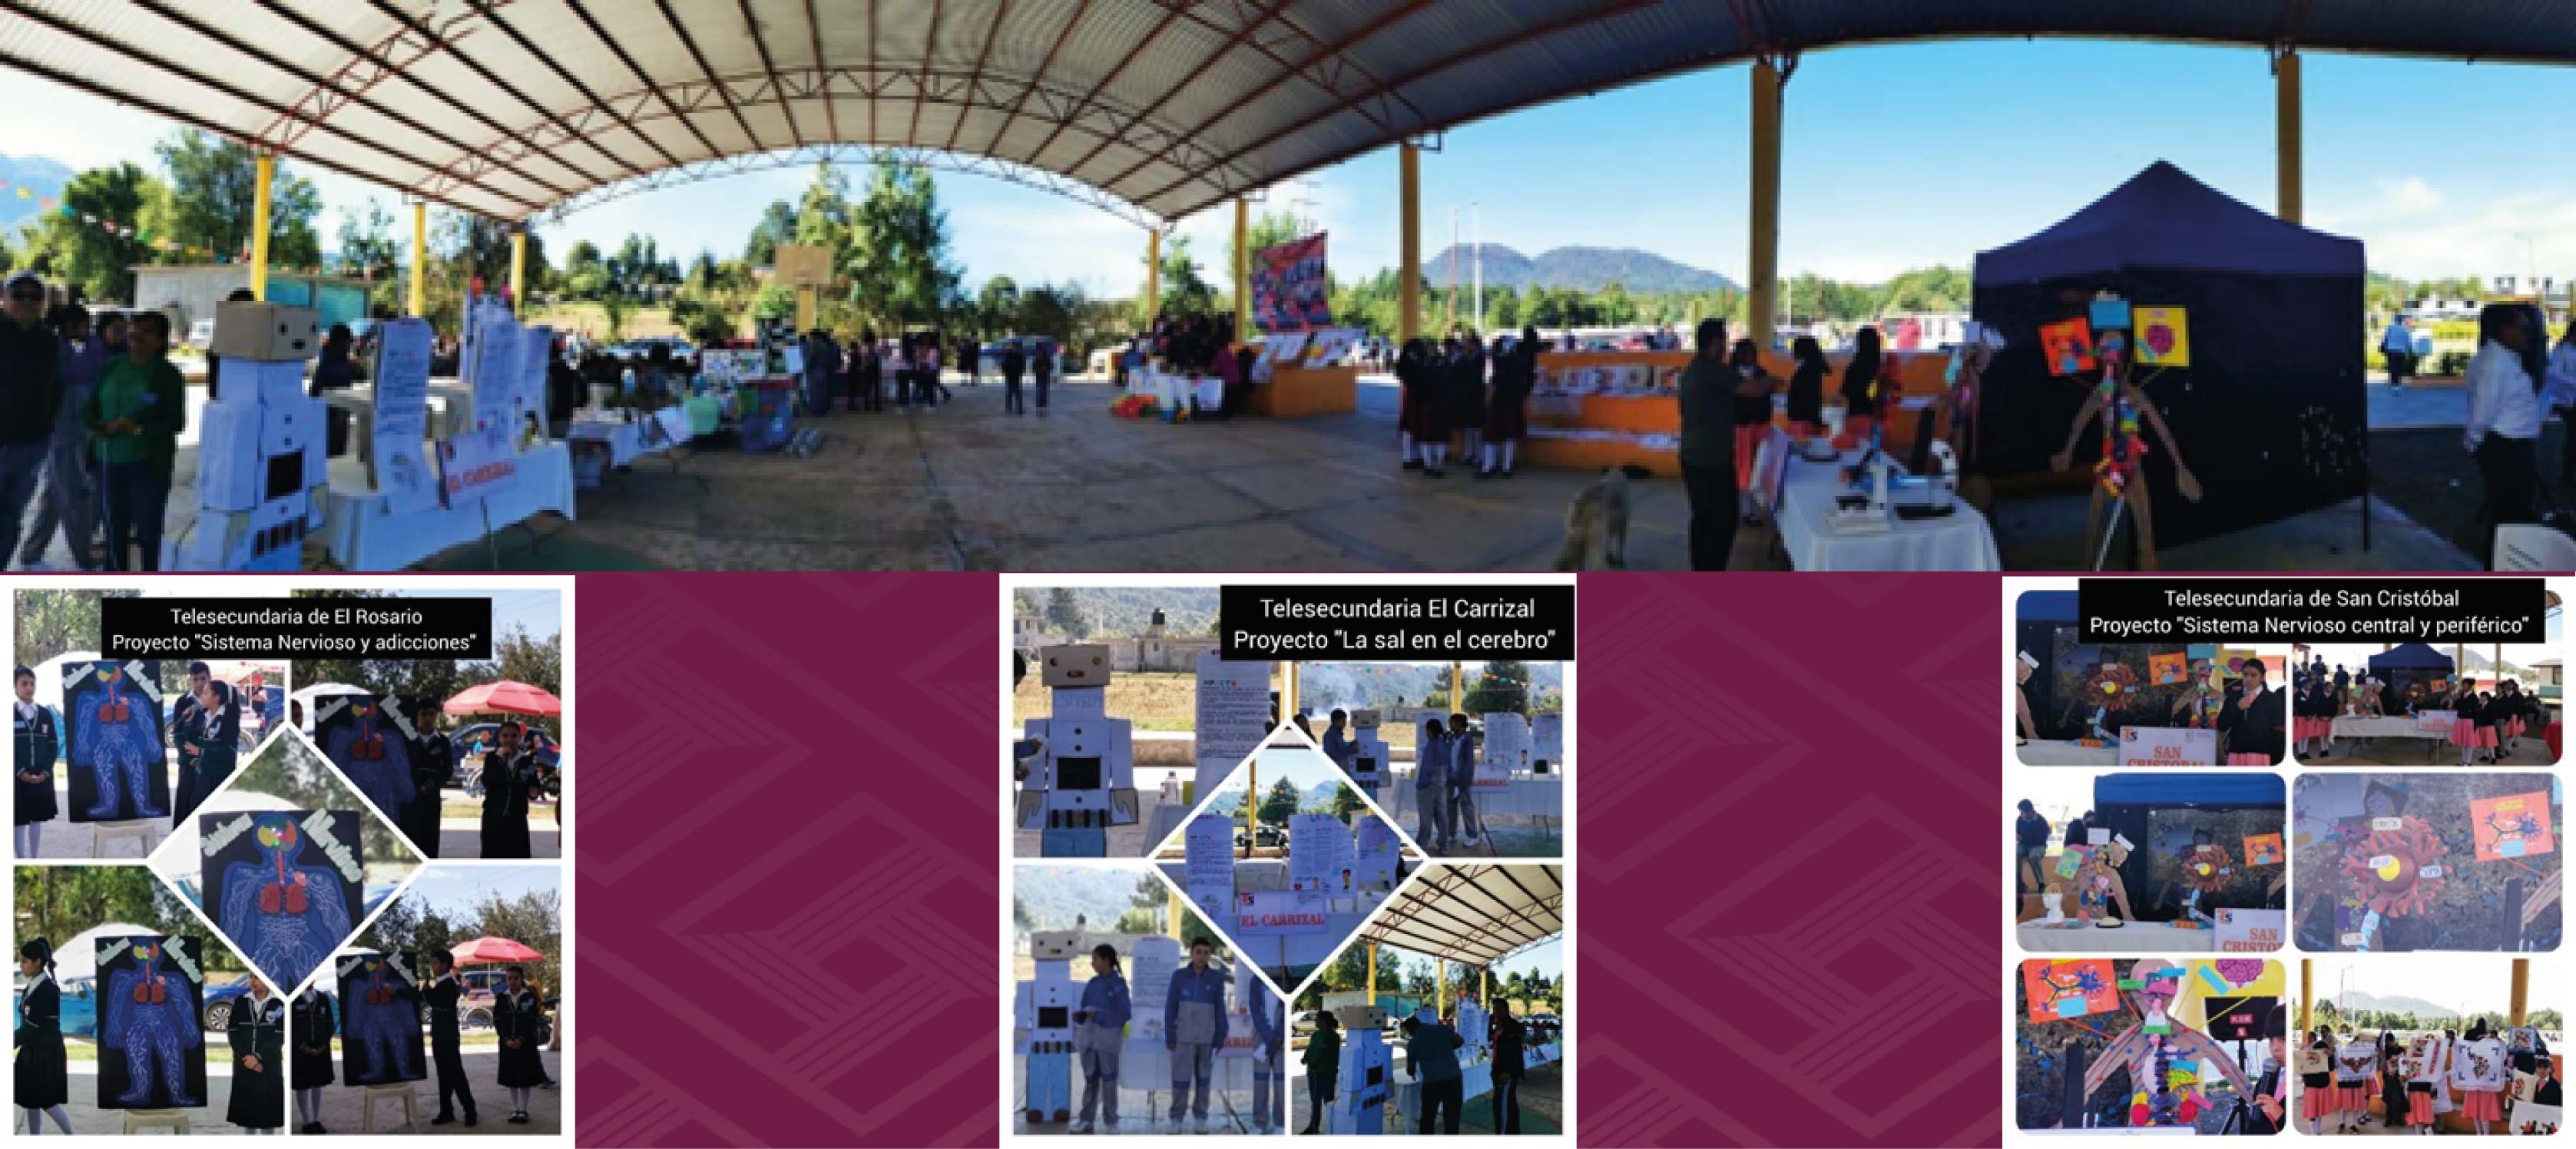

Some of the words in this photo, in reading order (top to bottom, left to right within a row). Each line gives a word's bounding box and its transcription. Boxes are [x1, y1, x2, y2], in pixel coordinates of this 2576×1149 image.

[2154, 745, 2182, 759] SAN
[1241, 914, 1258, 927] EL
[1261, 913, 1325, 926] CARRIZAL
[2250, 928, 2278, 941] SAN
